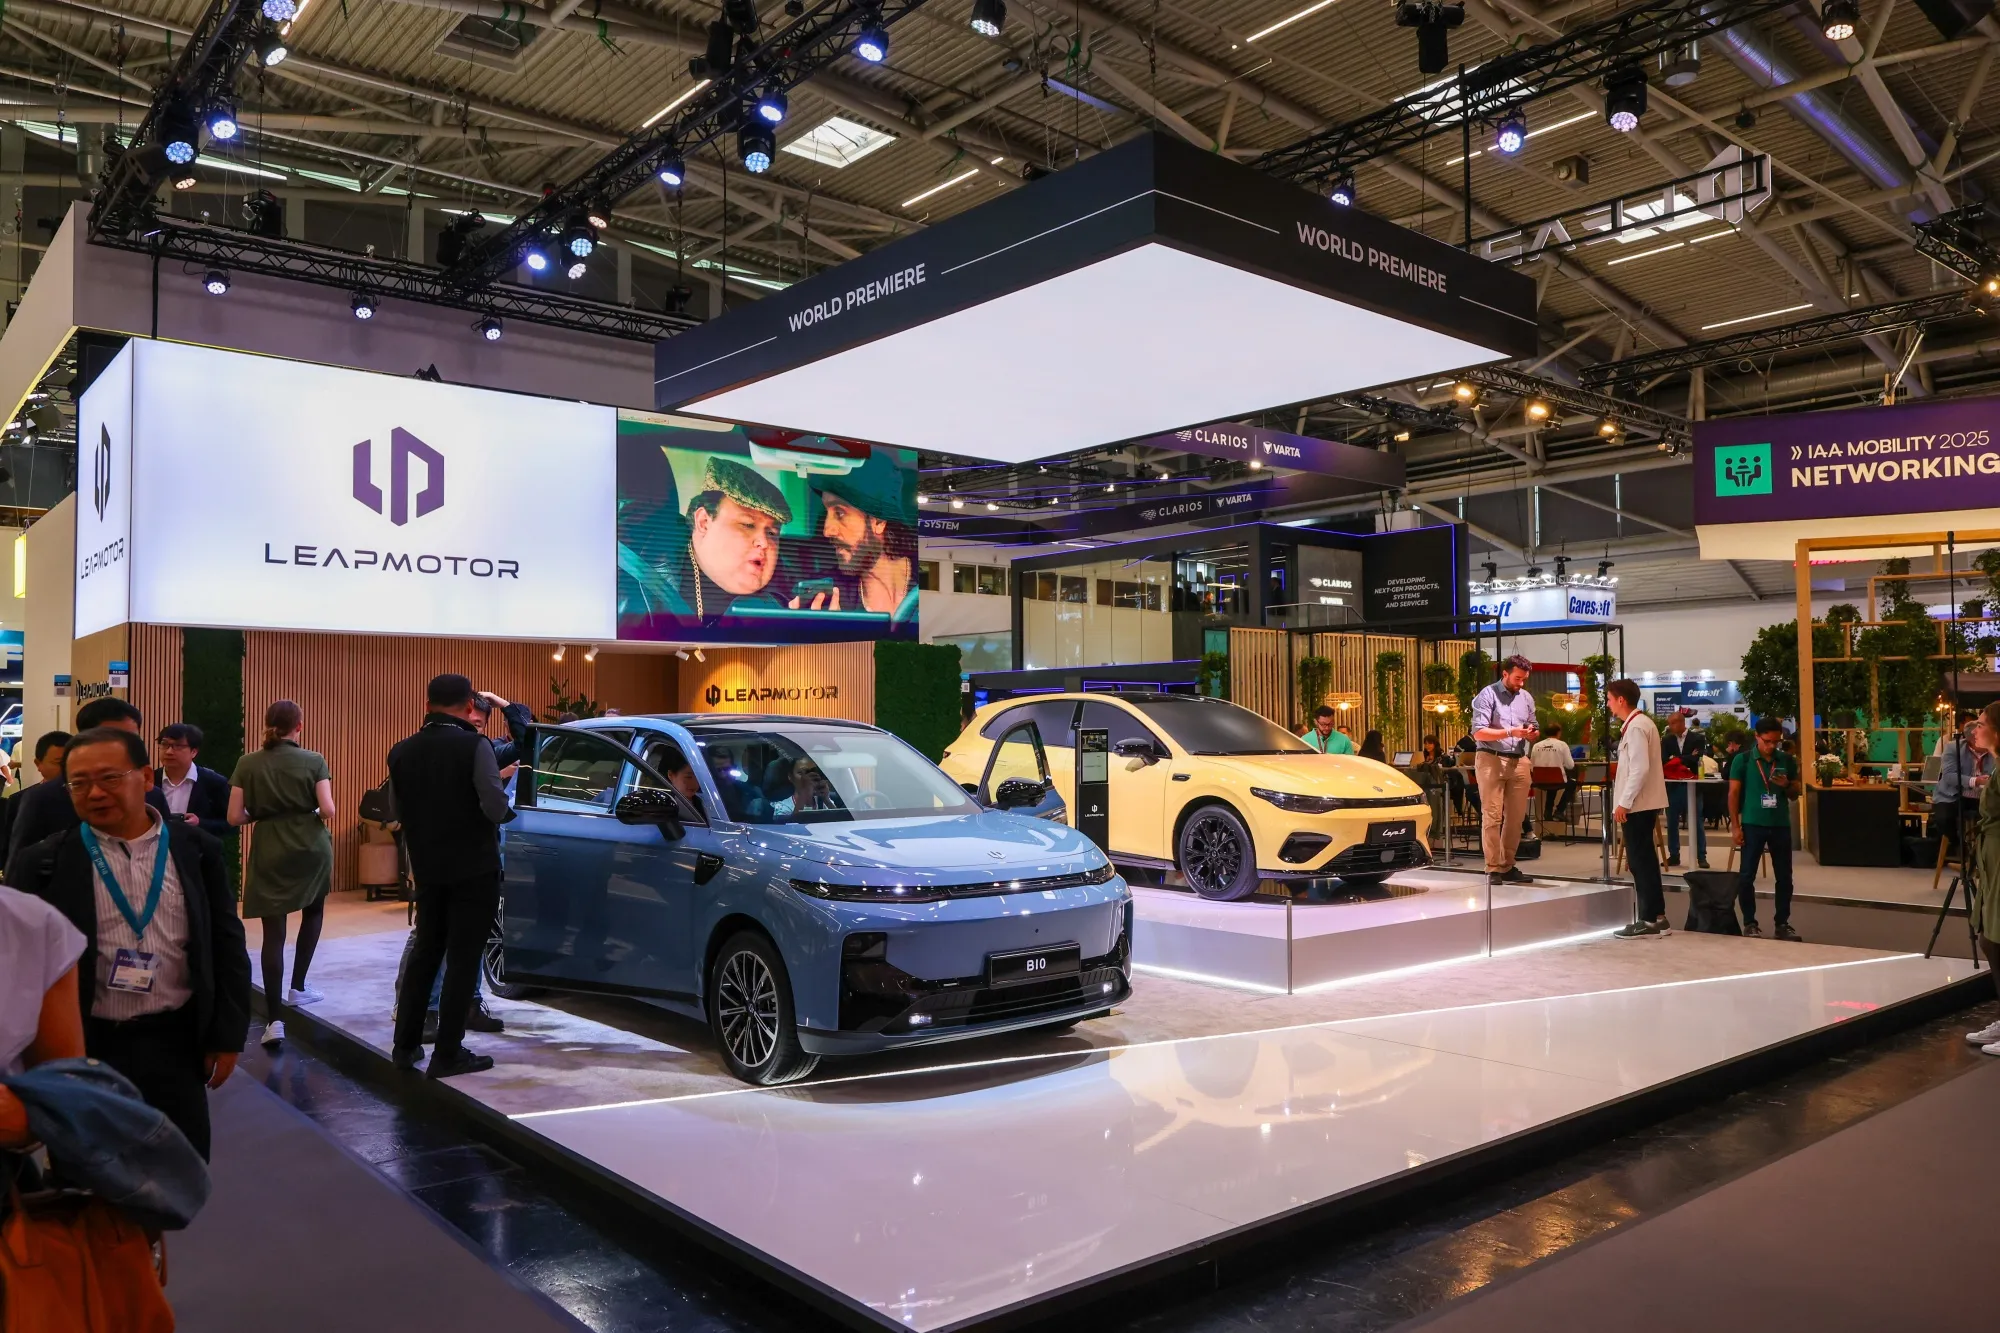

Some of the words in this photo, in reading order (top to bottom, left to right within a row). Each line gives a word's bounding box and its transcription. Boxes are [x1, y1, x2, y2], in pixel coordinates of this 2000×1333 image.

[1297, 222, 1364, 263] WORLD
[1369, 247, 1447, 293] PREMIERE
[789, 297, 842, 332] WORLD
[846, 263, 926, 310] PREMIERE
[1195, 430, 1248, 450] CLARIOS
[1808, 443, 1843, 460] IAA
[1848, 435, 1936, 457] MOBILITY
[1939, 430, 1990, 449] 2025
[1273, 444, 1301, 458] VARTA
[1791, 452, 2000, 488] NETWORKING
[1226, 493, 1252, 506] VARTA
[1159, 501, 1203, 517] CLARIOS
[924, 520, 960, 531] SYSTEM
[80, 537, 124, 580] LEAPMOTOR
[265, 543, 519, 579] LEAPMOTOR
[1322, 578, 1353, 589] CLARIOS
[1374, 585, 1404, 594] NEXT-GEN
[1404, 583, 1440, 592] PRODUCTS,
[1387, 576, 1426, 586] DEVELOPING
[1385, 601, 1399, 609] AND
[1400, 599, 1429, 608] SERVICES
[1393, 592, 1420, 601] SYSTEMS
[1470, 601, 1512, 617] esoft
[1569, 596, 1611, 616] Caresoft
[725, 686, 839, 702] LEAPMOTOR
[1026, 957, 1046, 972] B10
